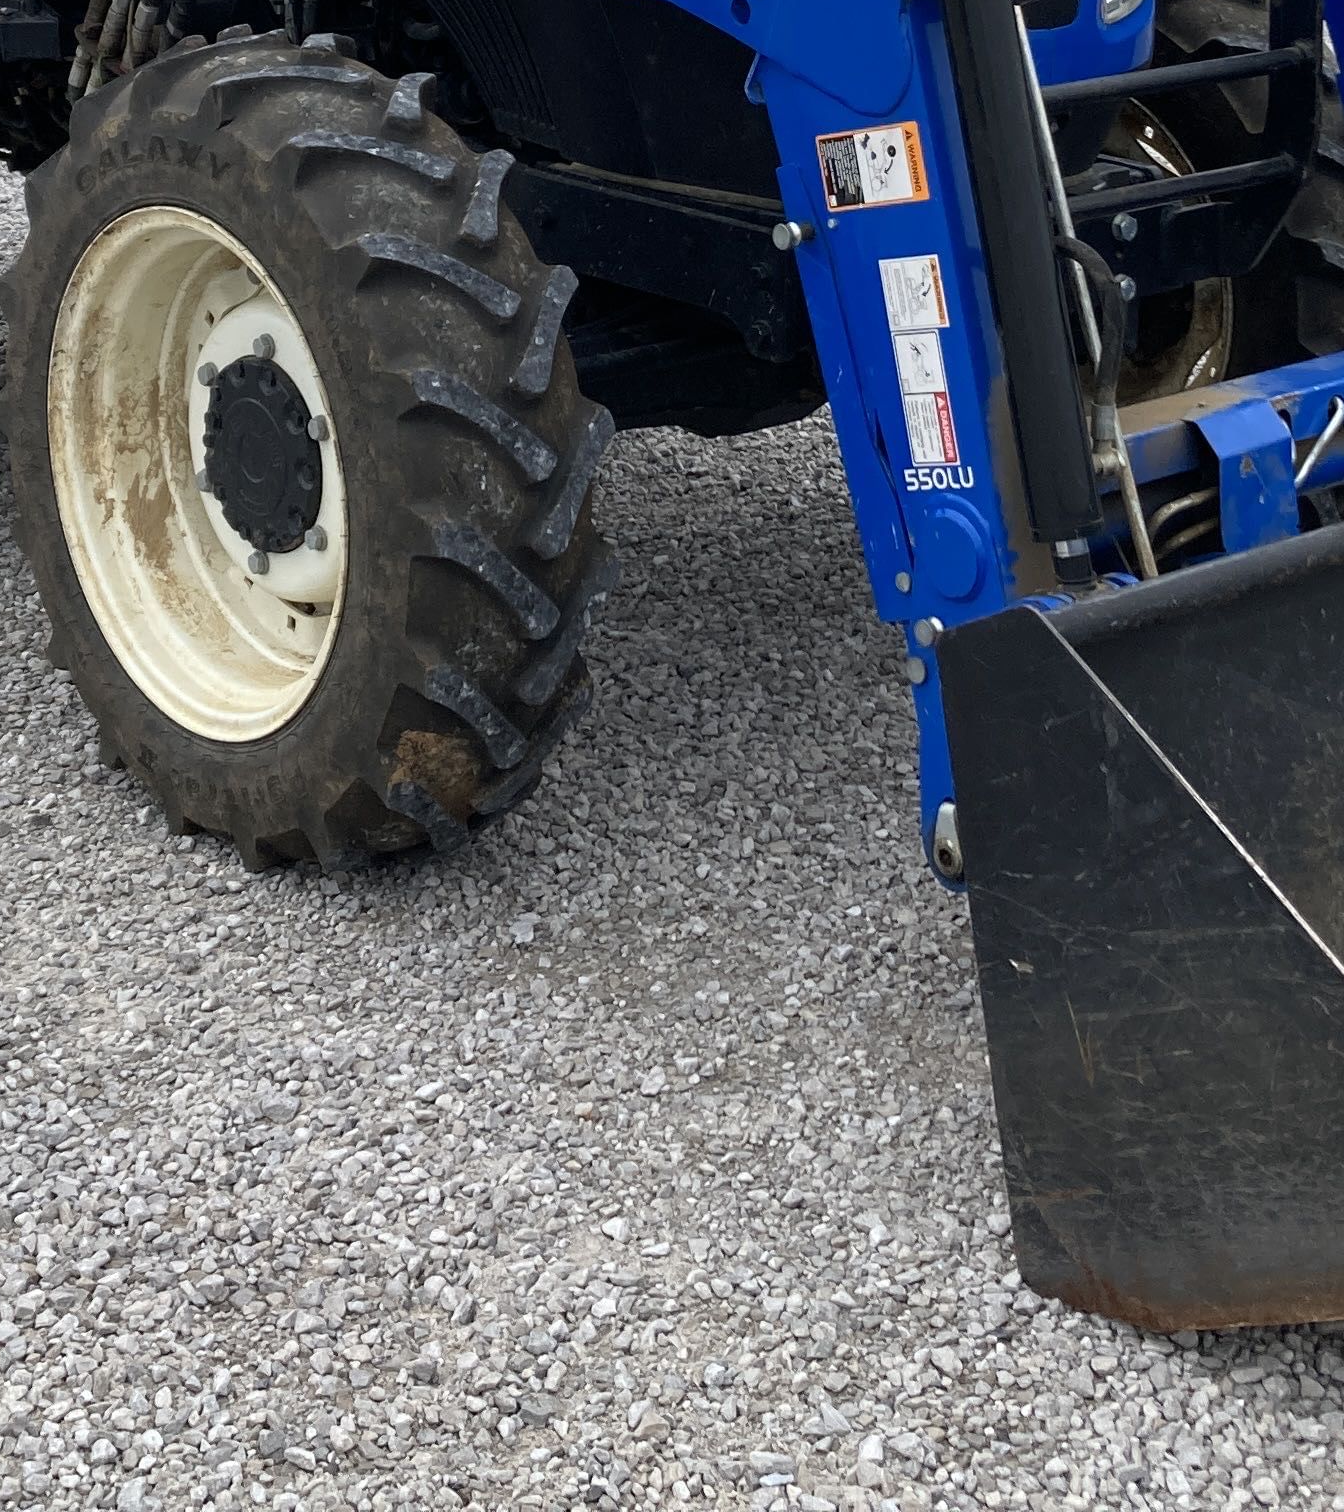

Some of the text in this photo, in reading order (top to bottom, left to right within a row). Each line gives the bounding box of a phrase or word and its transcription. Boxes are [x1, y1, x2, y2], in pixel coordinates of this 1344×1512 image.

[906, 143, 922, 193] WARNING
[939, 409, 955, 458] DANGER
[903, 466, 974, 492] 550LU
